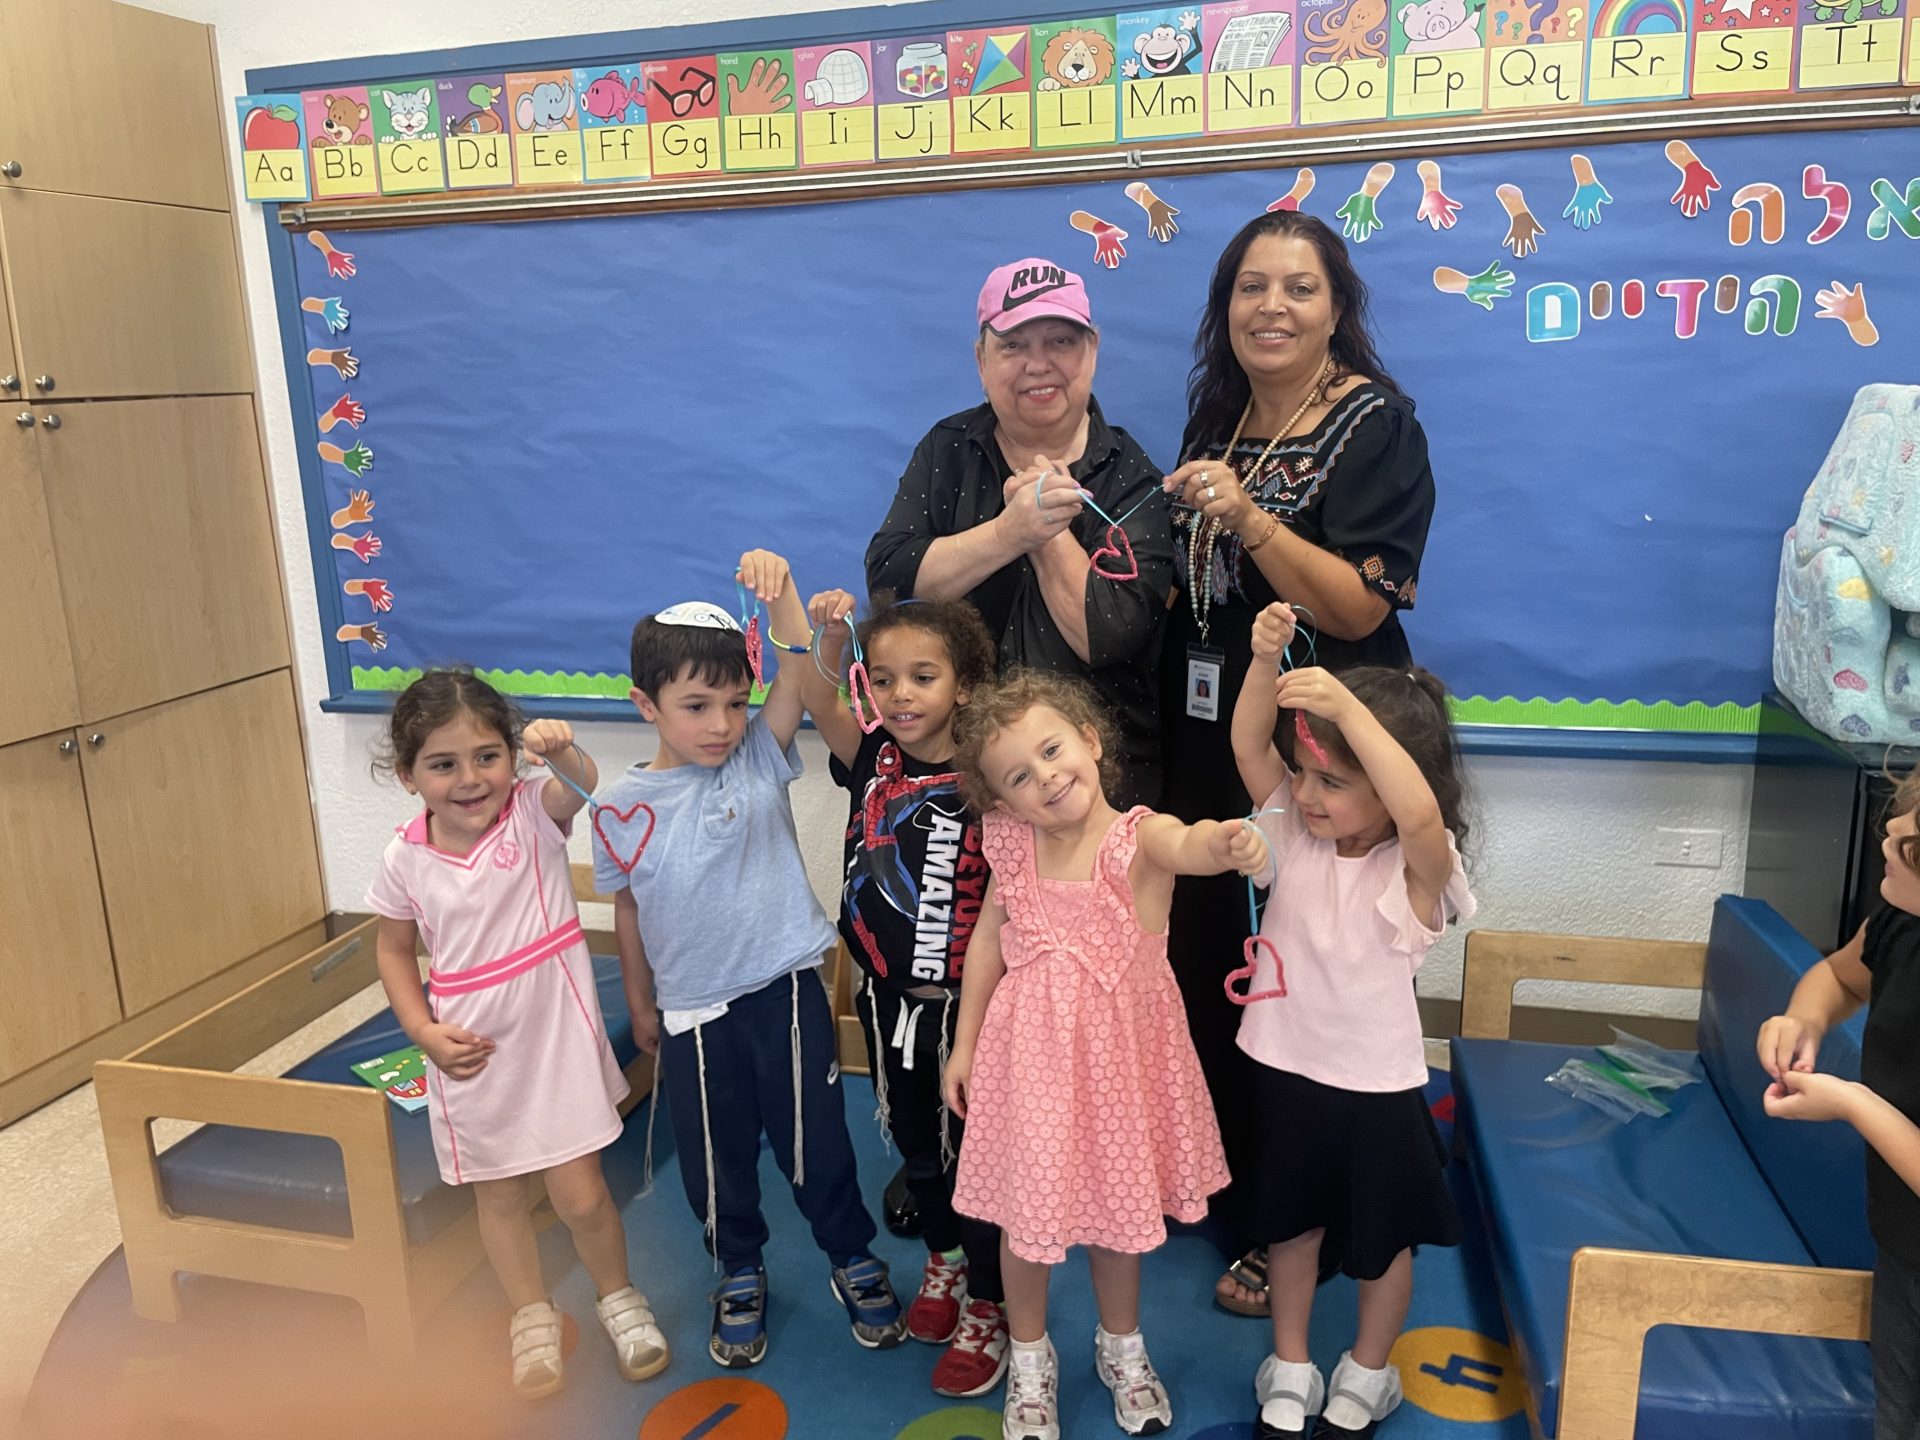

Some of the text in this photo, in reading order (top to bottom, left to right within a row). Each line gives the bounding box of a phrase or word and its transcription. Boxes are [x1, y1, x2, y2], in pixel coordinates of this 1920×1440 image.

[1120, 15, 1149, 25] monkey
[1206, 5, 1249, 16] newspaper
[876, 43, 888, 54] jar
[949, 34, 963, 43] kite
[1035, 28, 1049, 37] lion
[1824, 24, 1878, 65] Tt
[720, 56, 738, 65] hand
[1611, 38, 1665, 78] Rr
[1716, 33, 1769, 72] Ss
[438, 81, 453, 91] duck
[1224, 72, 1275, 111] Nn
[1315, 65, 1374, 102] Oo
[1413, 56, 1465, 109] Pp
[1500, 49, 1570, 101] Qq
[969, 97, 1015, 133] Kk
[1130, 80, 1197, 119] Mm
[600, 128, 635, 162] Ff
[662, 124, 708, 169] Gg
[738, 117, 782, 151] Hh
[895, 105, 934, 154] Jj
[254, 153, 294, 183] Aa
[324, 148, 363, 180] Bb
[391, 145, 430, 174] Cc
[458, 138, 498, 170] Dd
[533, 135, 568, 167] Ee
[1728, 164, 1920, 247] אלה
[1010, 265, 1067, 293] RUN
[1526, 273, 1802, 342] הידיים
[911, 813, 963, 983] AMAZING
